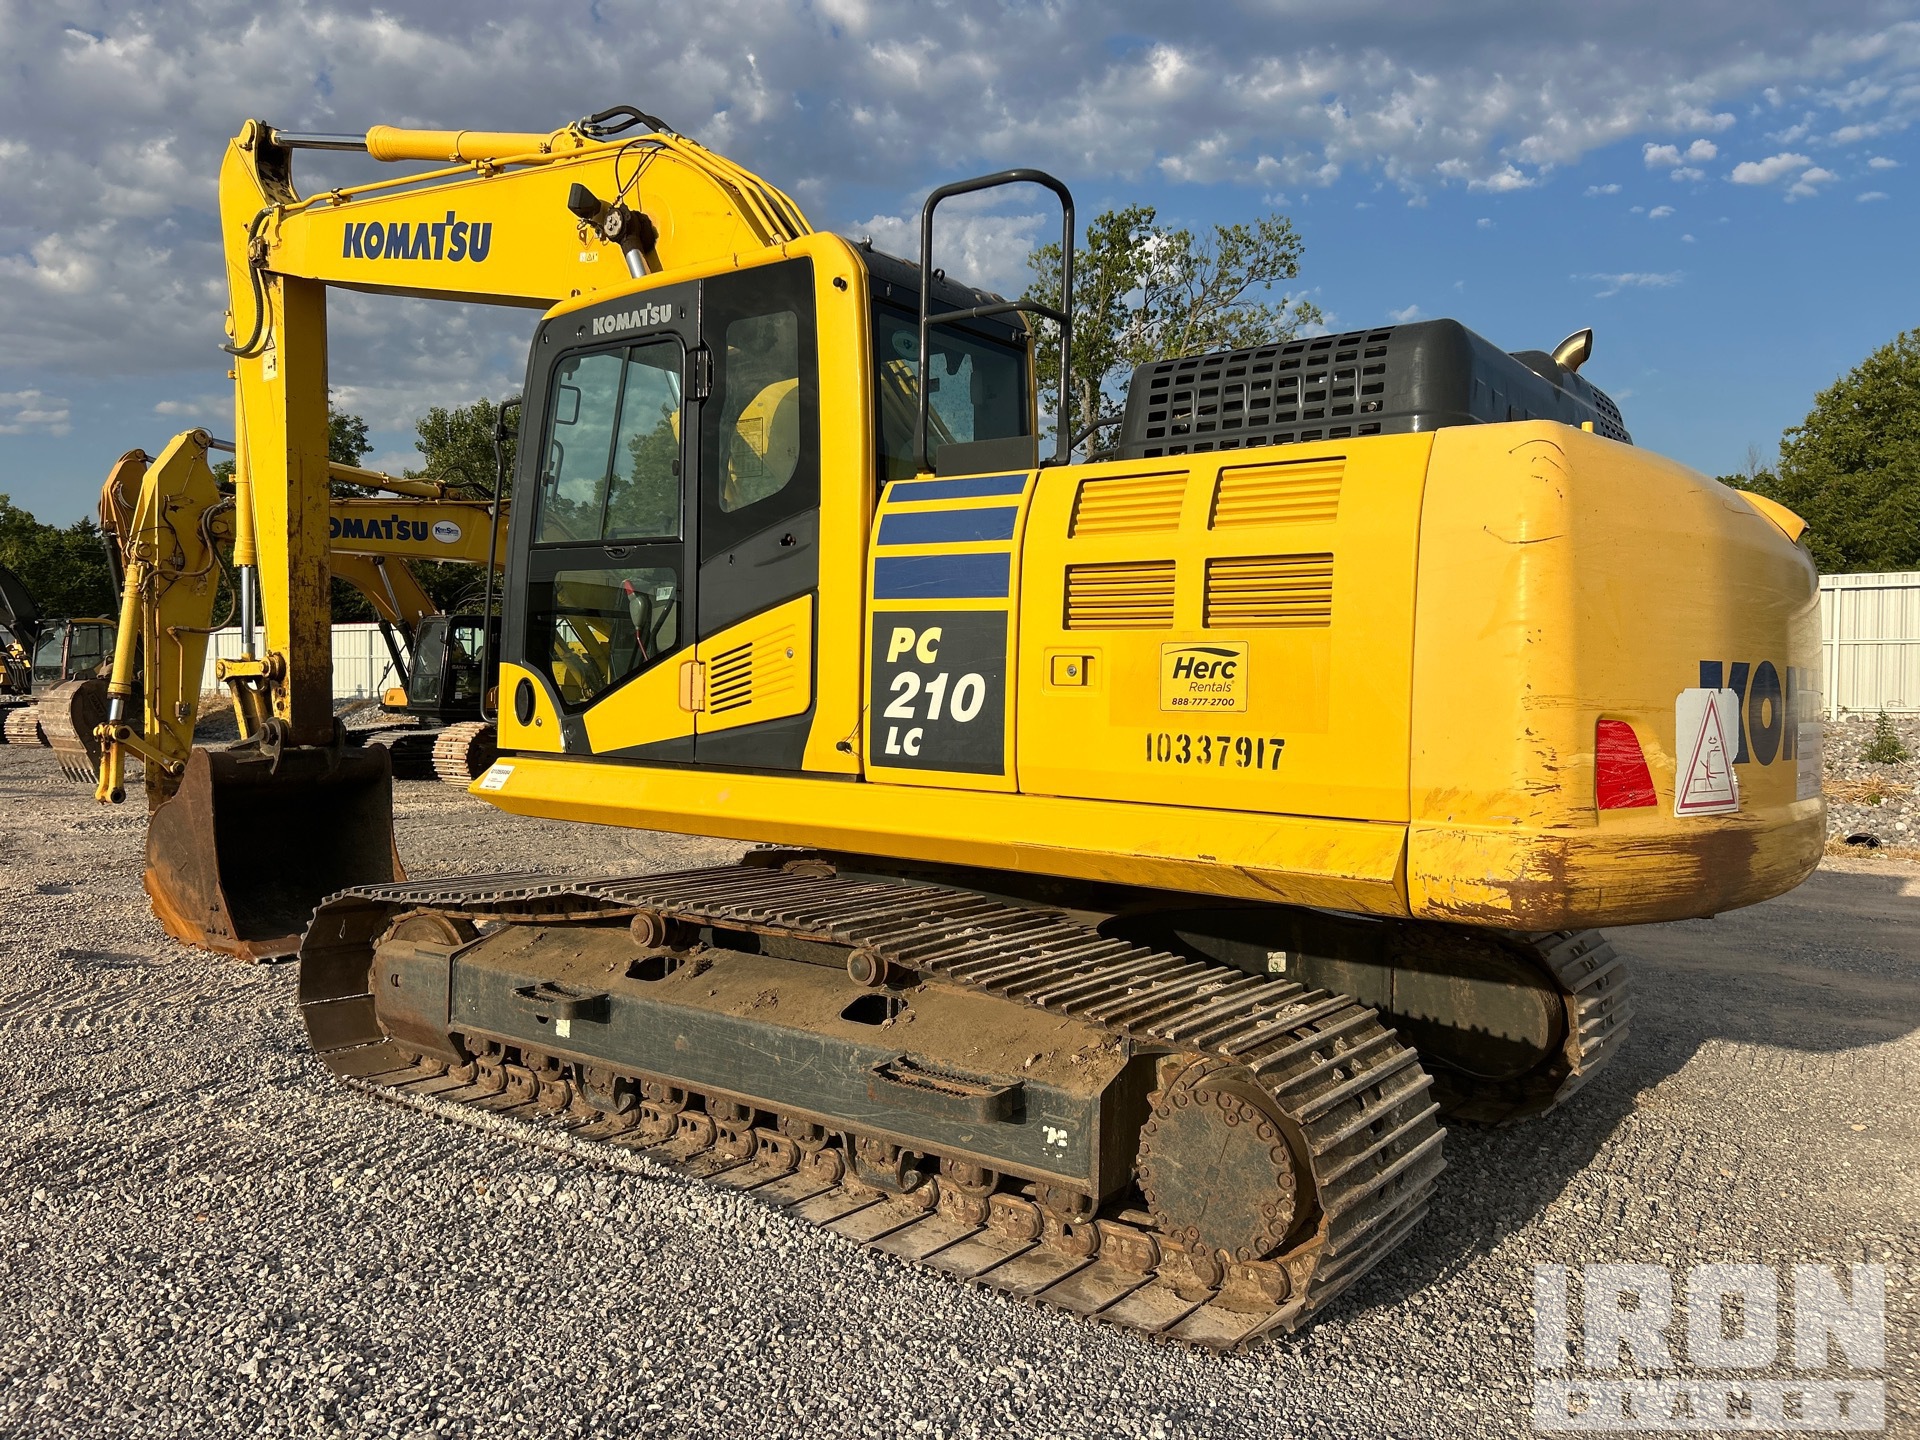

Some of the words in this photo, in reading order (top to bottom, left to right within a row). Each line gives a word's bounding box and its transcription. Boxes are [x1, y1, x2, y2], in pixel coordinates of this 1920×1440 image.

[342, 210, 493, 262] KOMATSU
[592, 302, 672, 335] KOMATSU
[329, 514, 429, 541] OMATSU
[886, 626, 943, 664] PC
[1172, 656, 1237, 679] Herc
[883, 671, 986, 723] 210
[1171, 697, 1235, 706] 888-777-2700
[884, 726, 924, 756] LC
[1146, 732, 1286, 771] 10337917
